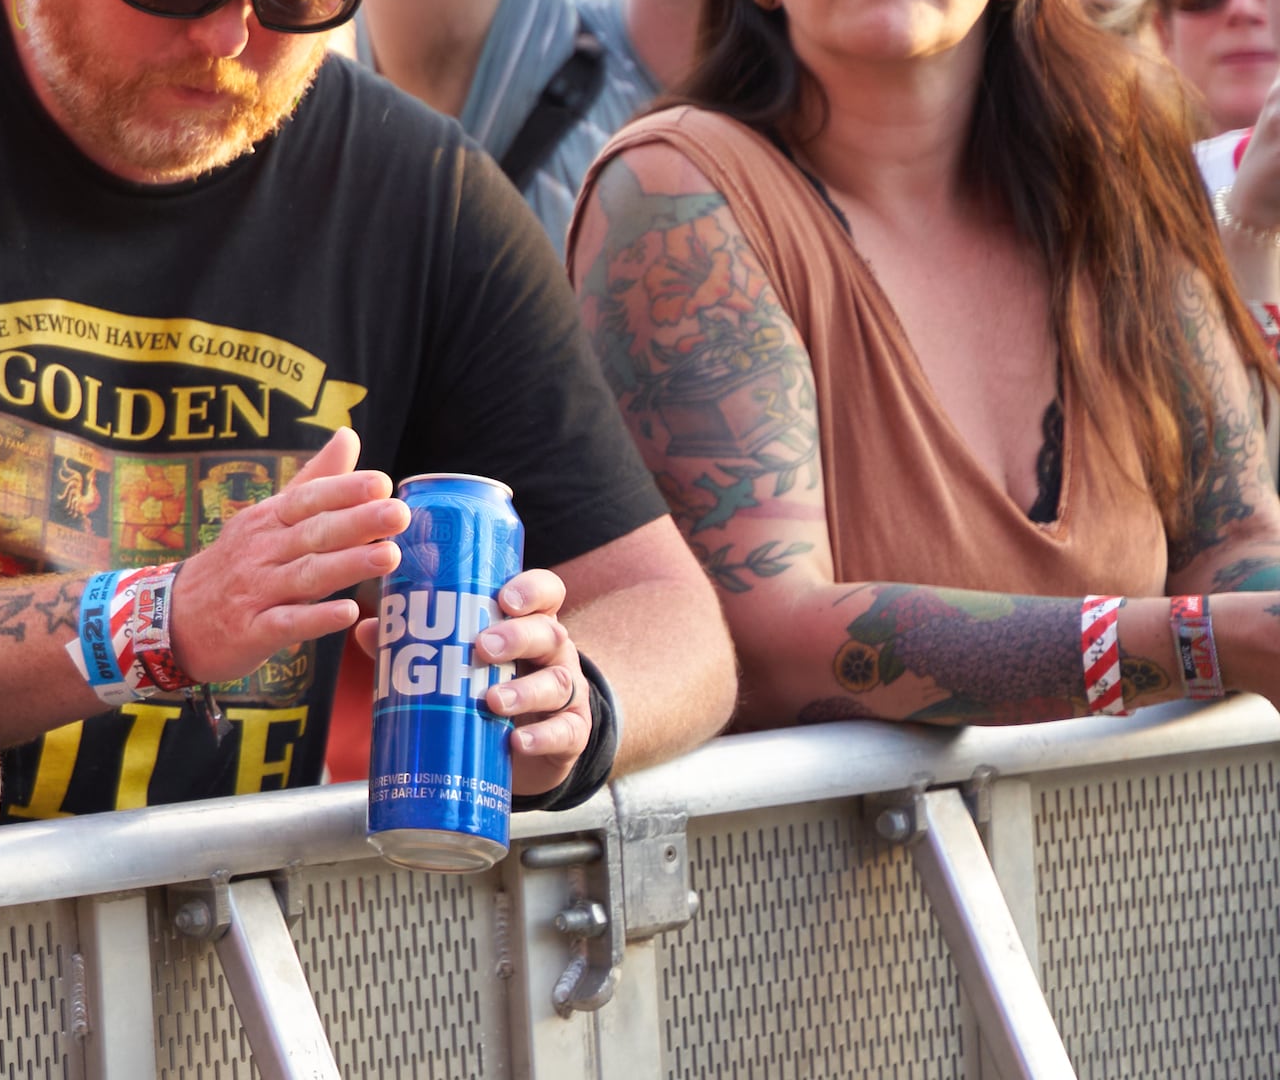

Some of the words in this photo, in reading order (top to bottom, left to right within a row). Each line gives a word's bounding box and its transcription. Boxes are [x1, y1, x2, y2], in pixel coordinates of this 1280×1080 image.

[15, 313, 100, 341] NEWTON
[105, 326, 182, 352] HAVEN
[189, 333, 306, 382] GLORIOUS
[83, 603, 105, 643] 21
[136, 589, 154, 634] VIP
[378, 590, 504, 648] BUD
[92, 642, 115, 680] OVER
[264, 655, 308, 684] END
[374, 643, 517, 702] IGHT
[1191, 633, 1214, 679] VIP
[376, 773, 411, 788] BREWED
[415, 773, 452, 786] USING
[454, 775, 477, 790] THE
[391, 787, 436, 799] BARLEY
[476, 794, 496, 809] AND
